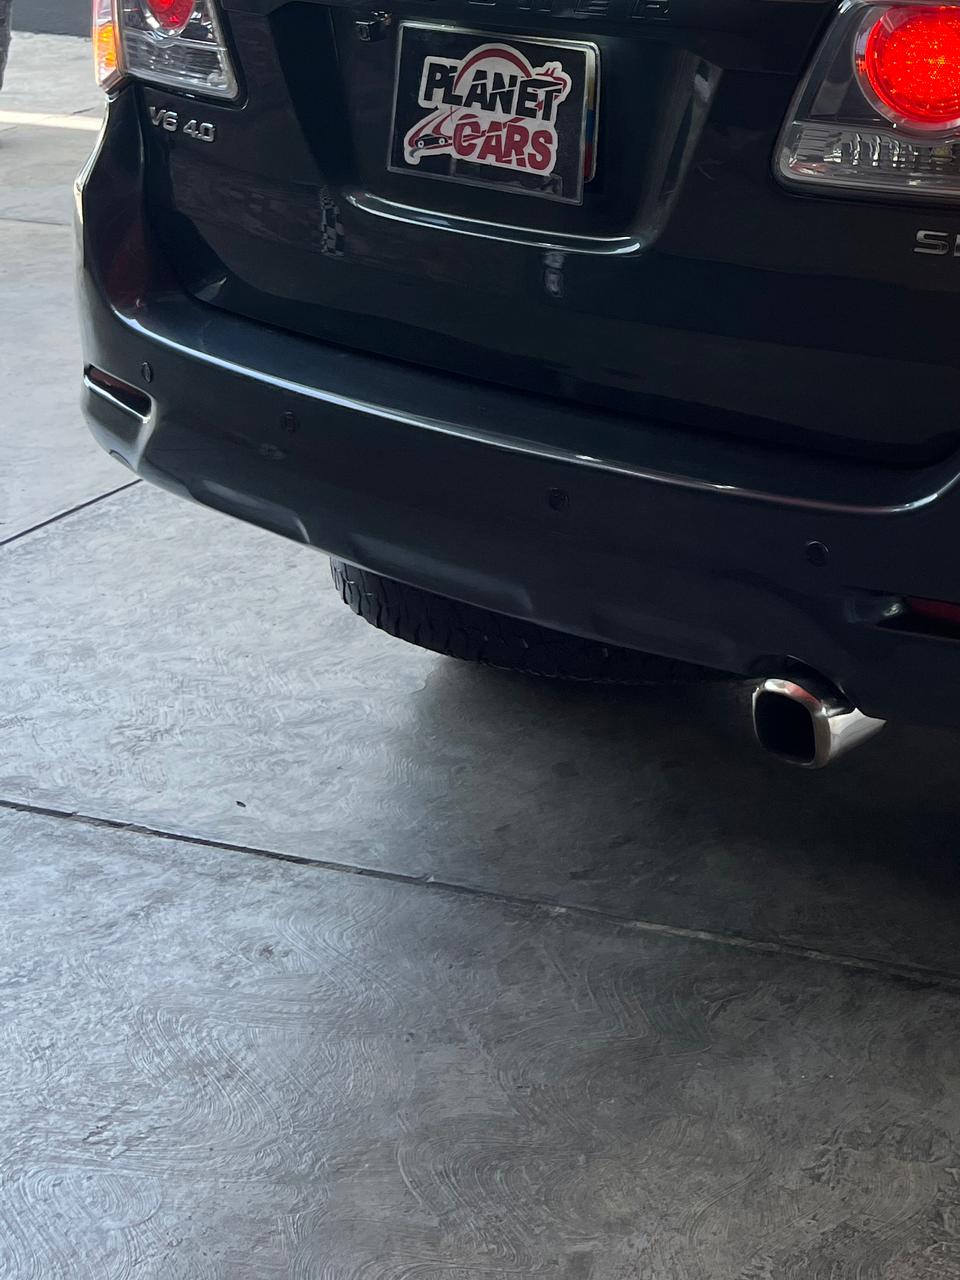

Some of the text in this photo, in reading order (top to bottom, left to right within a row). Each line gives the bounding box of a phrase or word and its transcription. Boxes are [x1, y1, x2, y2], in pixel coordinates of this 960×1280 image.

[423, 62, 565, 122] PLANET
[148, 106, 215, 143] V6 4.0
[453, 113, 554, 173] CARS
